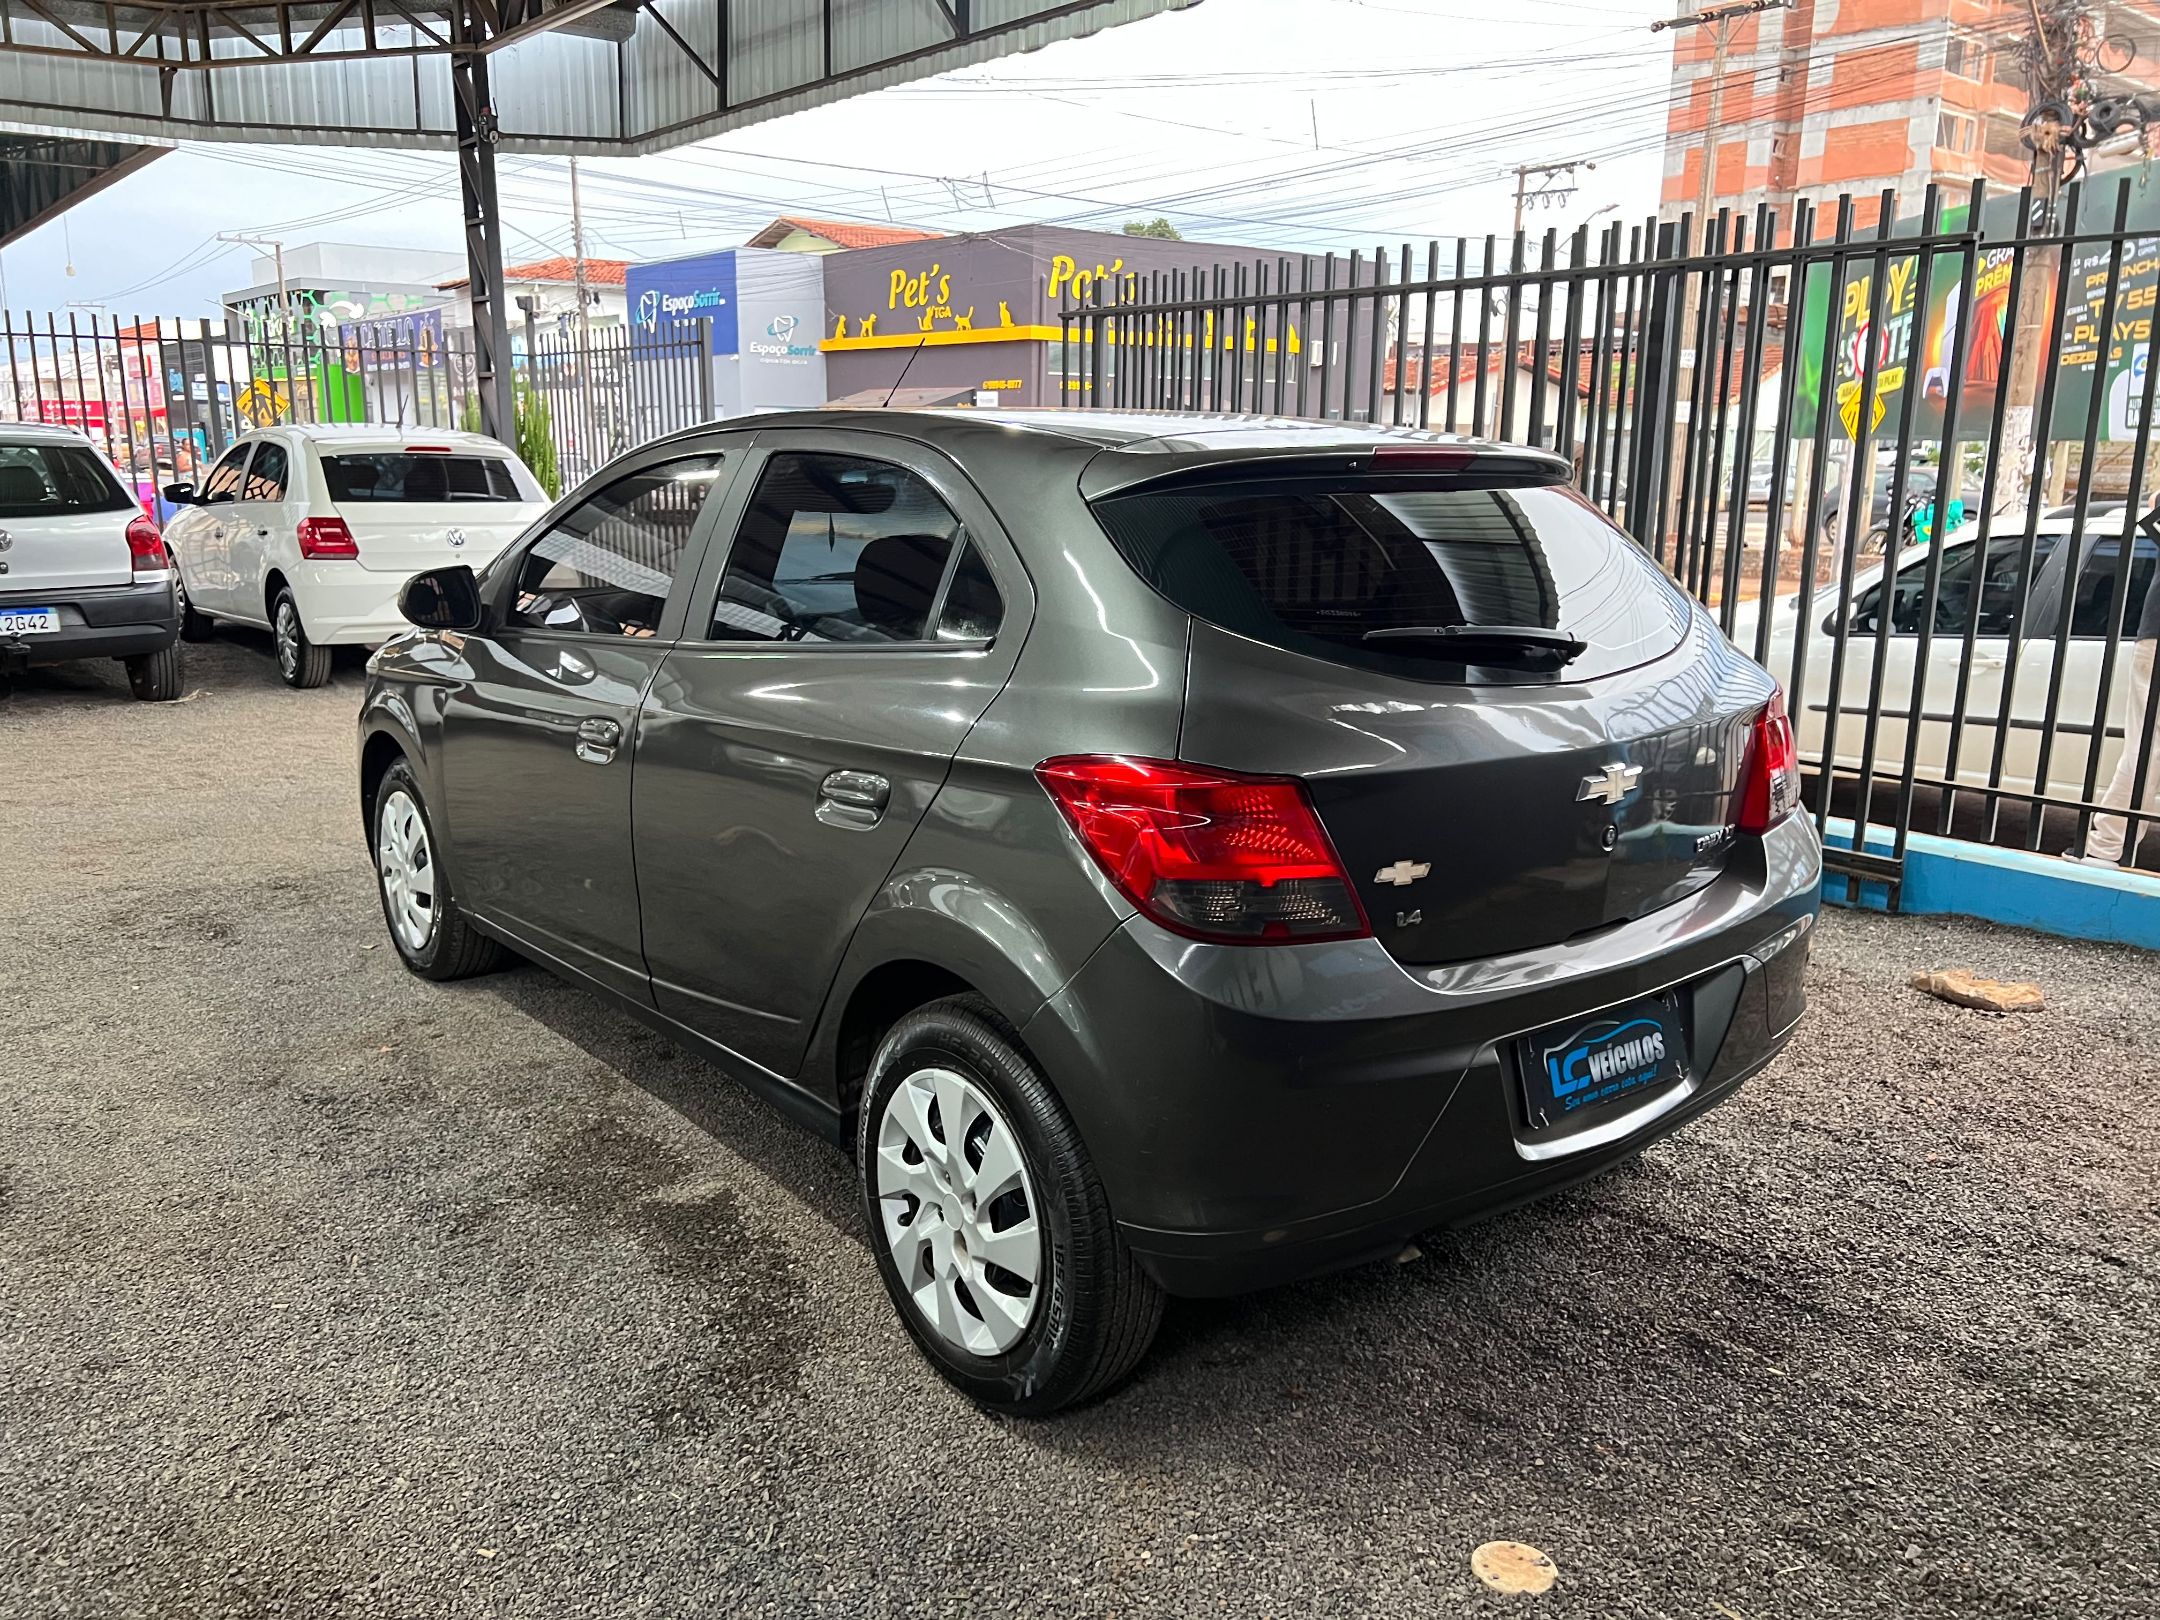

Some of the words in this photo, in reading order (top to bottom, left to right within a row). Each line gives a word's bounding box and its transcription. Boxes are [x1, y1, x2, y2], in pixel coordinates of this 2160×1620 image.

[889, 264, 951, 309] Pet's
[1843, 255, 1914, 332] PLY
[1975, 262, 2013, 297] PRÊM
[935, 306, 952, 319] TGA
[1844, 312, 1914, 376] STE
[0, 615, 48, 632] 2G42
[1548, 1046, 1592, 1098] LC
[1588, 1032, 1666, 1083] VEÍCULOS
